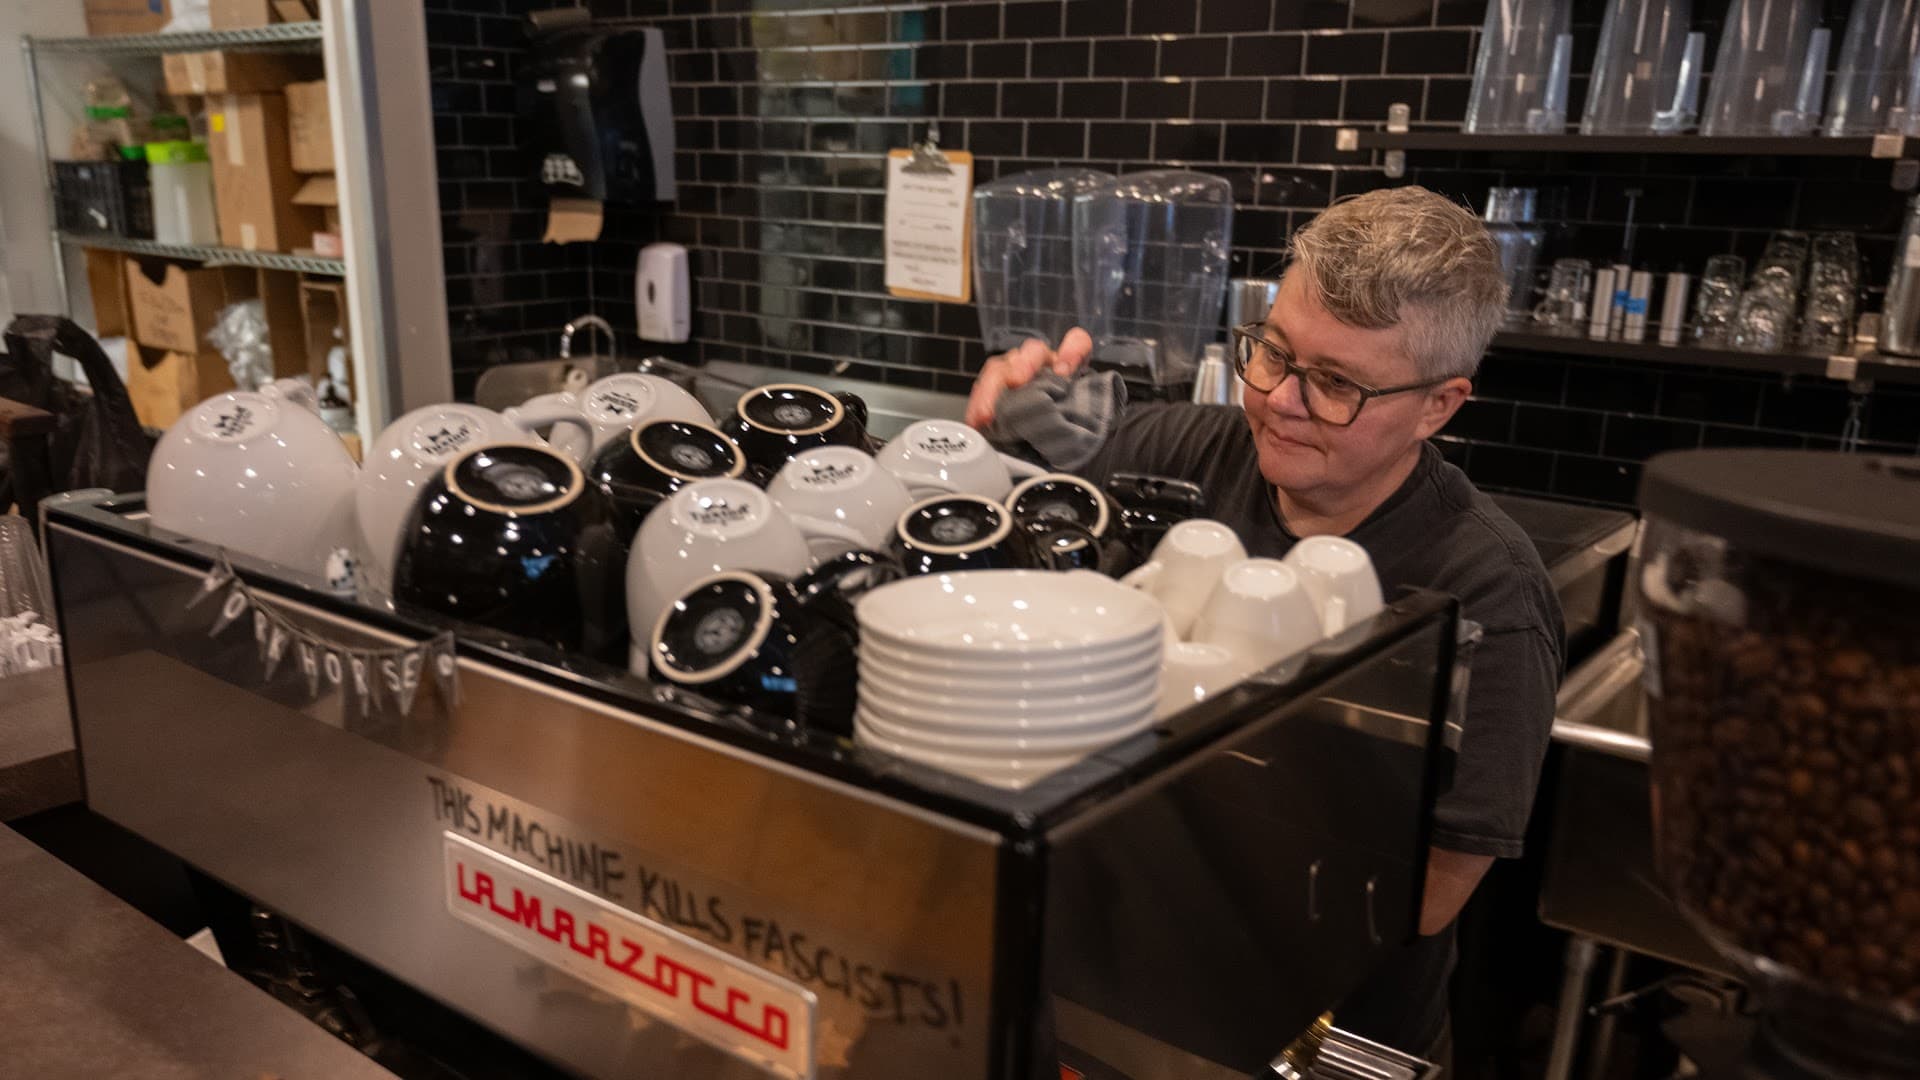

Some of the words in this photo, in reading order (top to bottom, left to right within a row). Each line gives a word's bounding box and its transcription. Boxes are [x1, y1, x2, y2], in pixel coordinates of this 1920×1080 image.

[299, 641, 420, 692] HORSE
[427, 776, 481, 834] THIS
[487, 803, 625, 900] MACHINE
[640, 866, 733, 943] KILLS
[742, 915, 964, 1048] FASCISTS!
